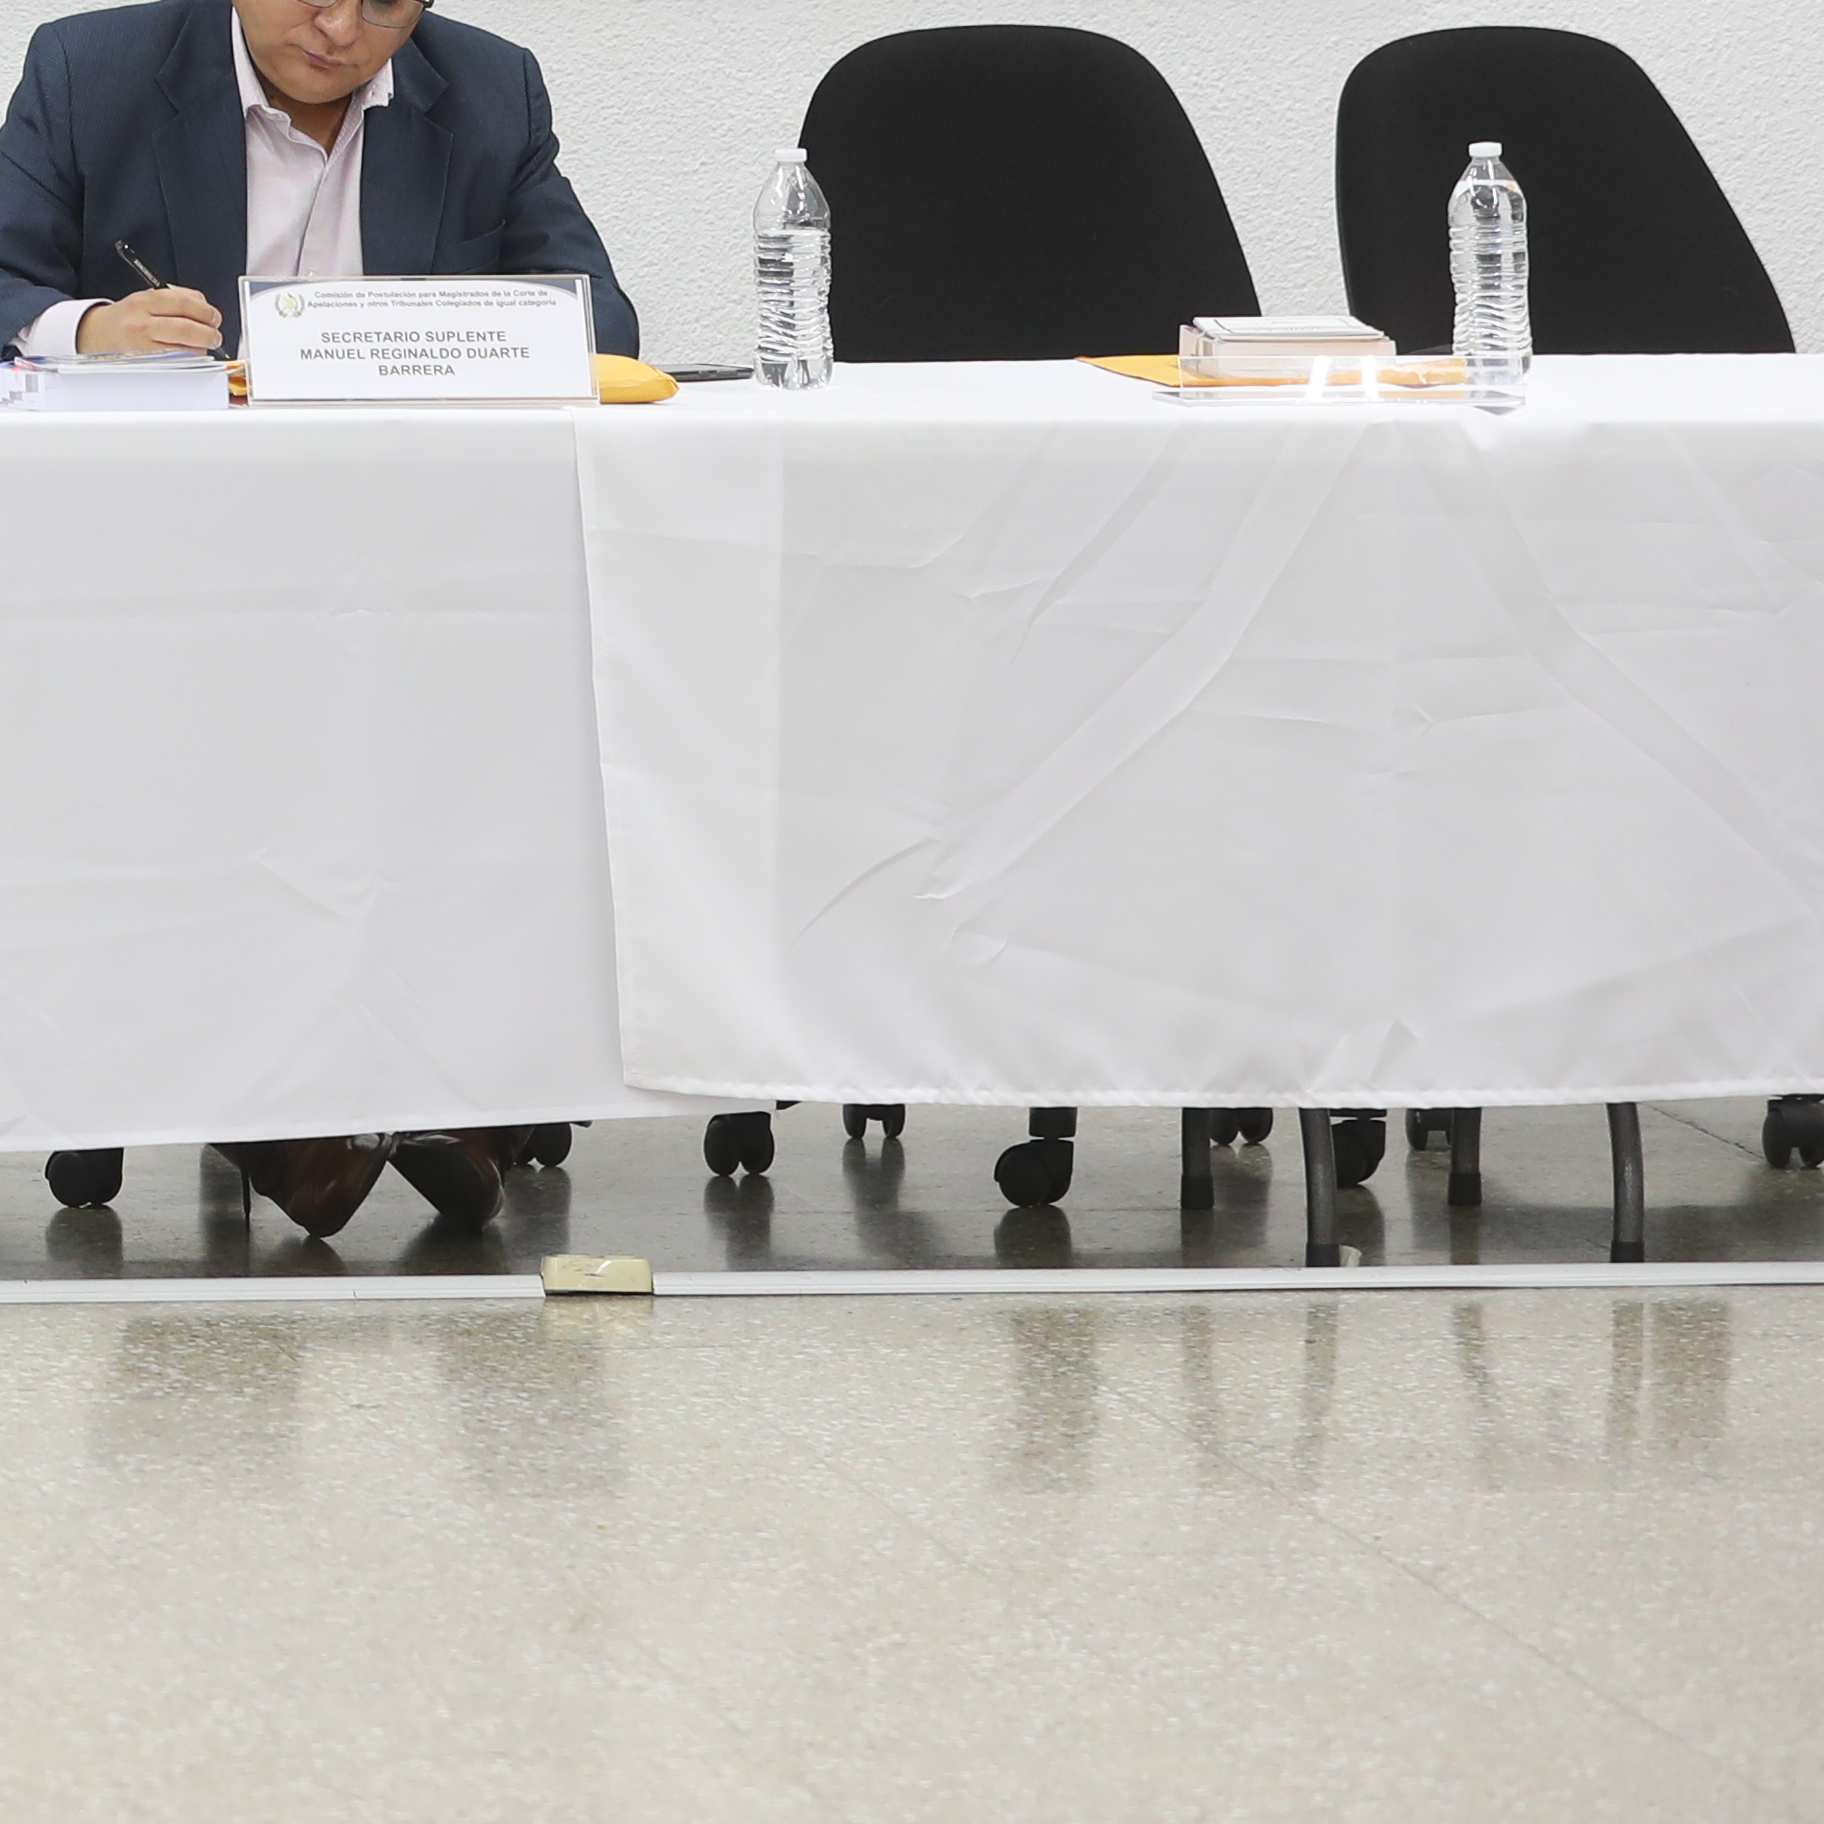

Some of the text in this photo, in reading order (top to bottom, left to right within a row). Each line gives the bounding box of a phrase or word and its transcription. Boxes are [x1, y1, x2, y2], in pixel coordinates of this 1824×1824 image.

[320, 330, 506, 344] SECRETARIO SUPLENTE
[299, 346, 530, 360] MANUEL REGINALDO DUARTE
[378, 364, 456, 376] BARRERA
